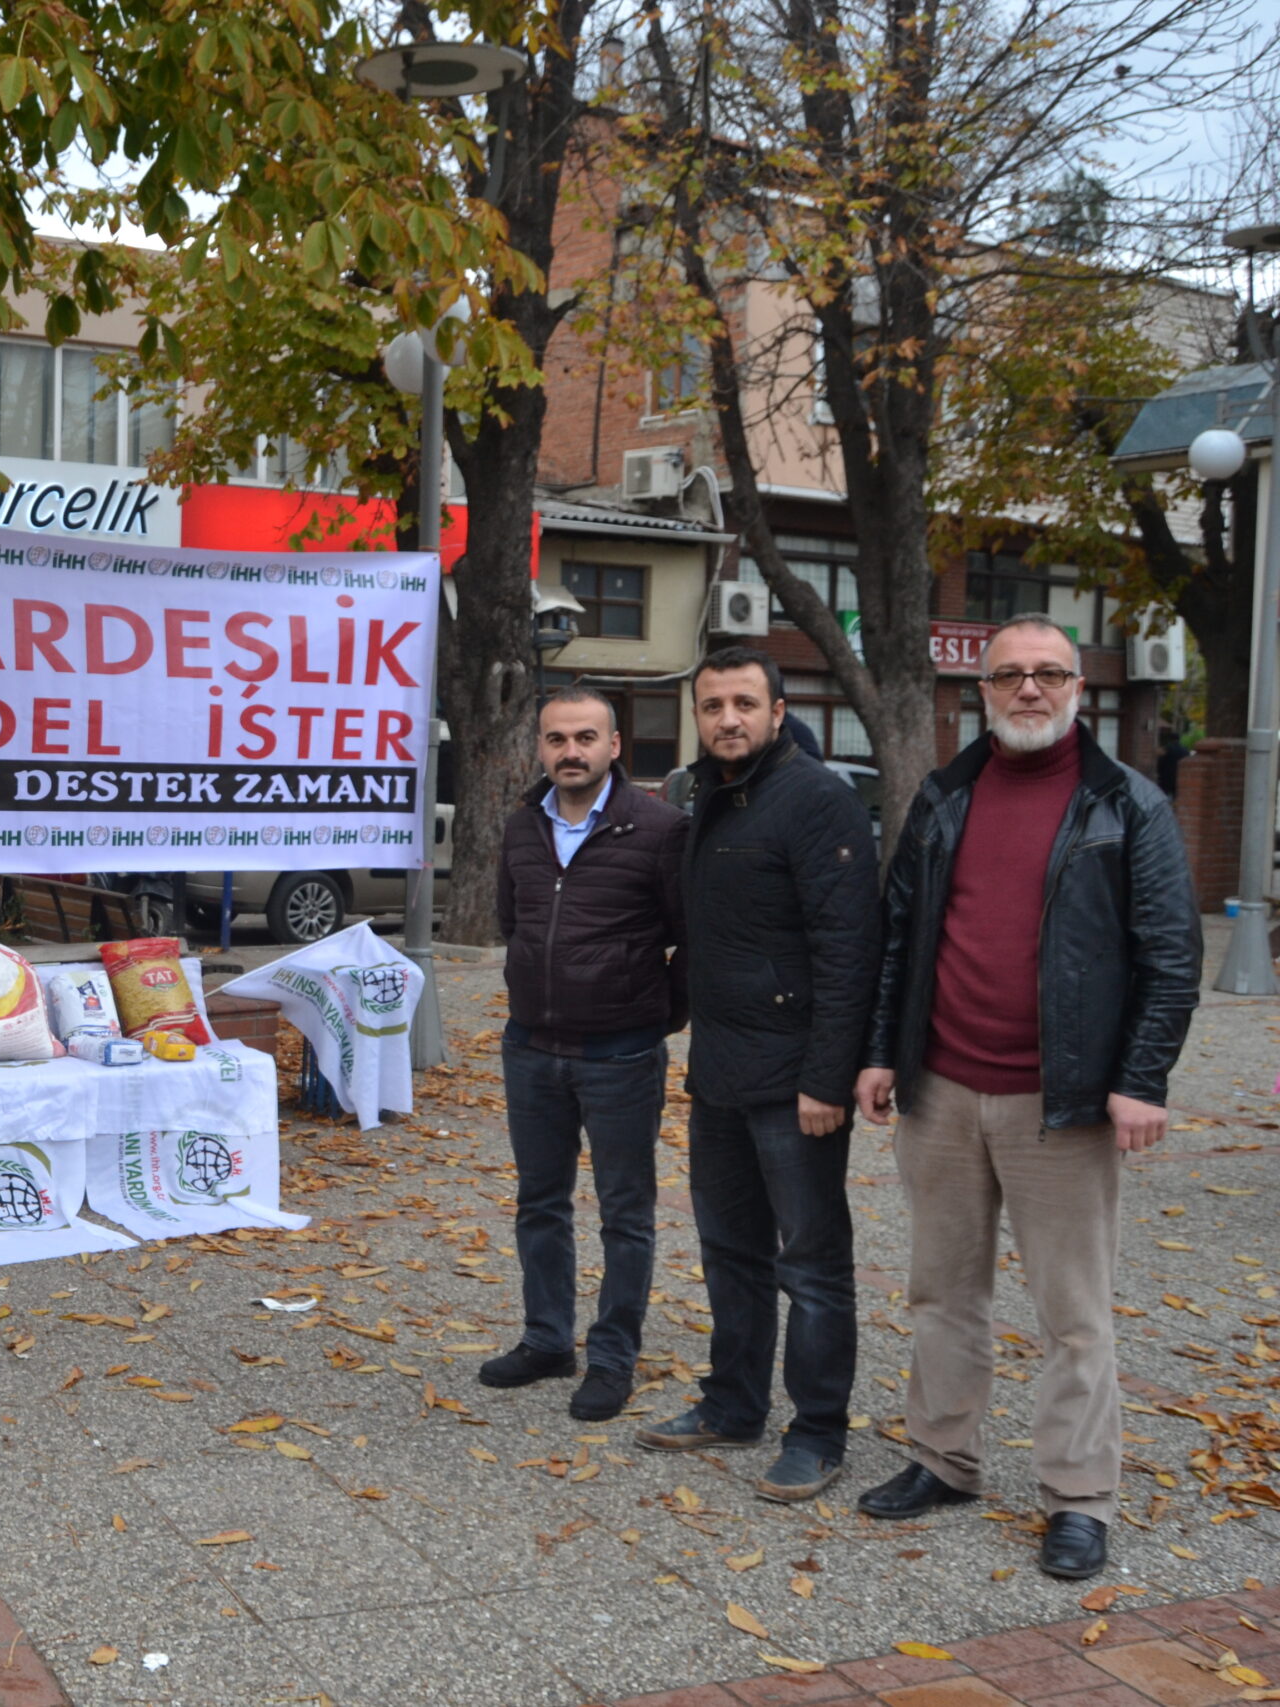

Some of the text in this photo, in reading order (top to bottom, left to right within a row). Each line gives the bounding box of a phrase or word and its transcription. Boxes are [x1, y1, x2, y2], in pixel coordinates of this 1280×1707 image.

[14, 770, 221, 803] DESTEK
[233, 773, 410, 804] ZAMANI
[145, 970, 173, 984] TAT
